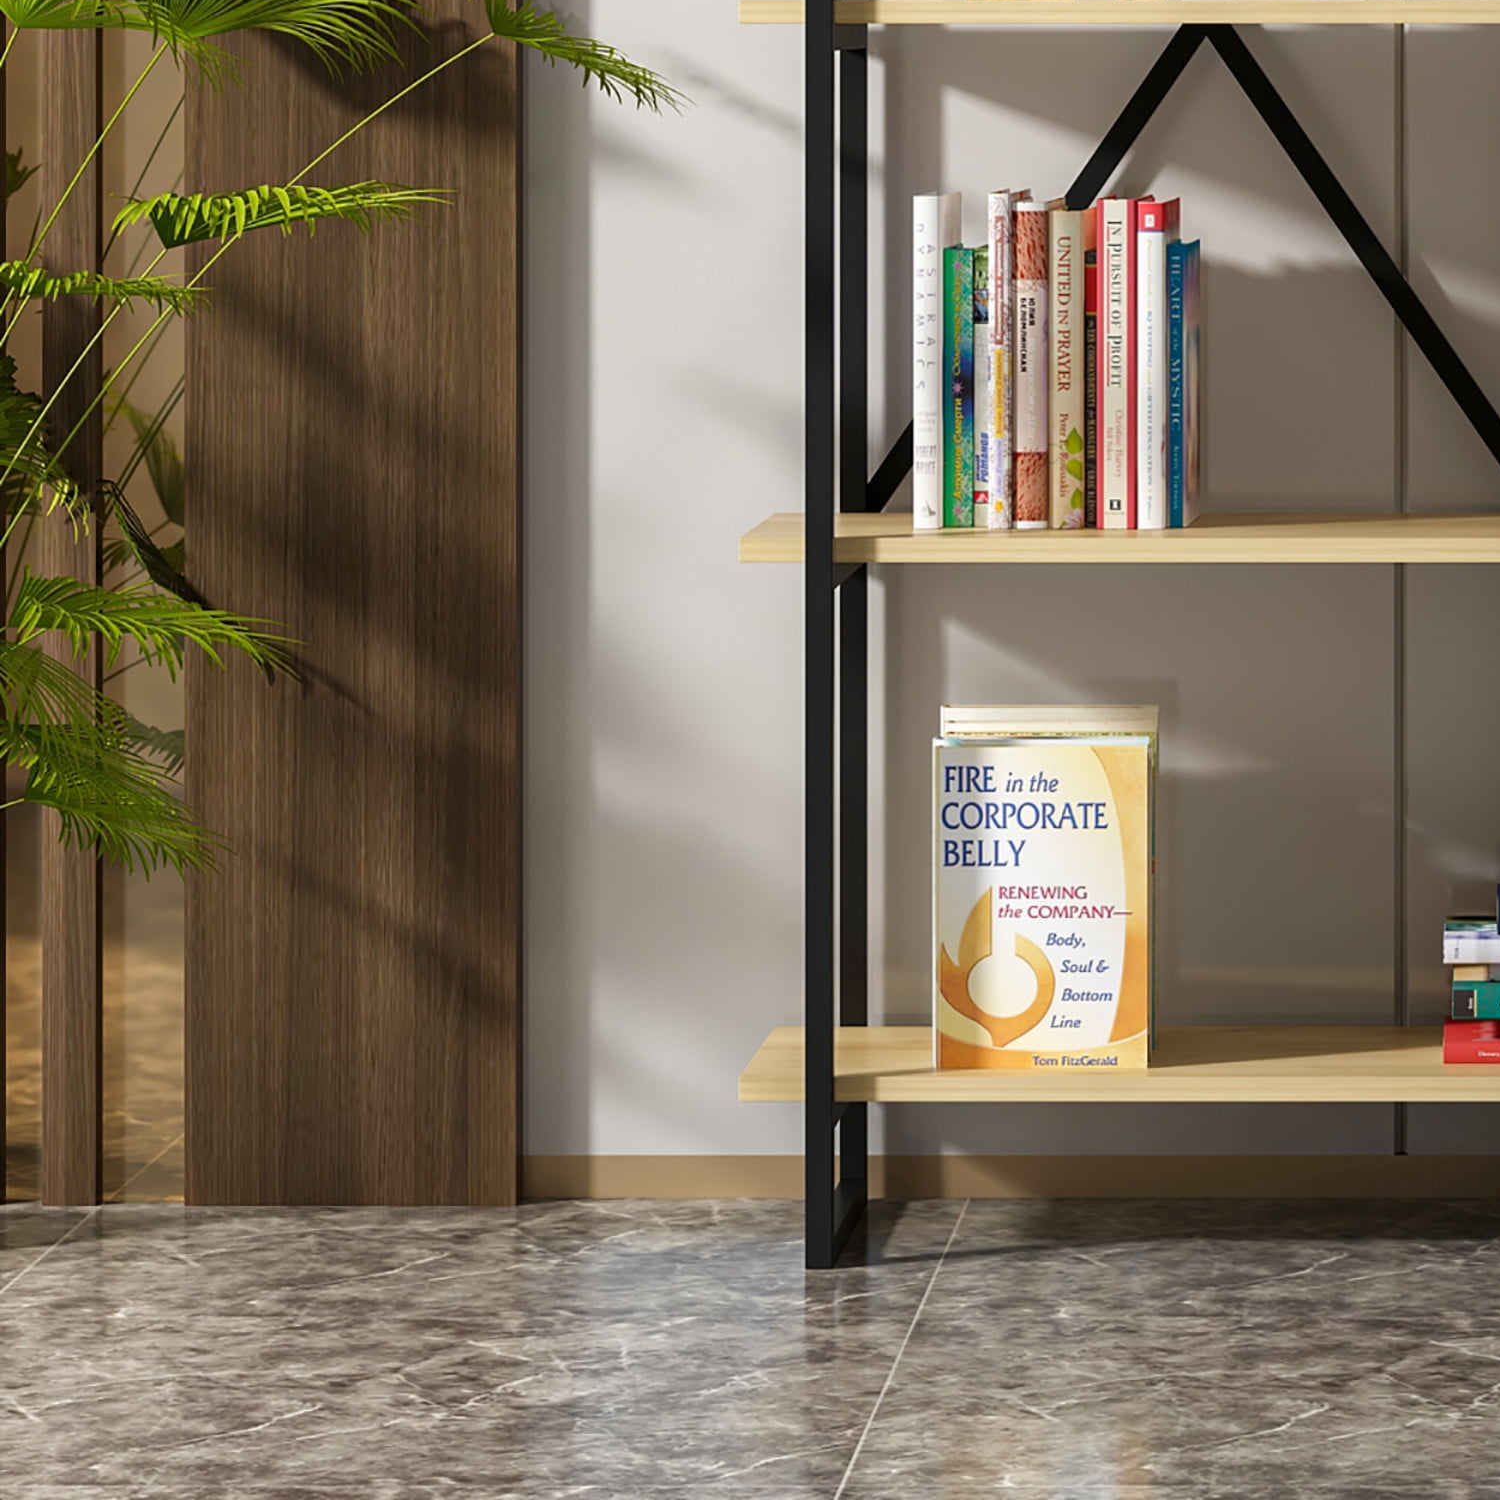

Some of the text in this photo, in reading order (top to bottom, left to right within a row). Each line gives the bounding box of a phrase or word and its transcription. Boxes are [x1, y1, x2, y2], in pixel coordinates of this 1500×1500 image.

[1171, 255, 1181, 323] HEART
[1057, 236, 1071, 392] UNITED IN PRAYER
[1107, 221, 1122, 388] IN PURSUIT OF PROFIT
[1171, 358, 1181, 432] MYSTIC
[944, 766, 1059, 793] FIRE in the
[941, 802, 1108, 829] CORPORATE
[943, 840, 1027, 867] BELLY
[998, 885, 1088, 900] RENEWING
[998, 905, 1023, 918] the
[1046, 933, 1086, 948] Body,
[1060, 960, 1110, 973] Soul &
[1061, 988, 1113, 1002] Bottom
[1050, 1015, 1082, 1029] Line
[1032, 1055, 1118, 1066] Tom FitzGerald
